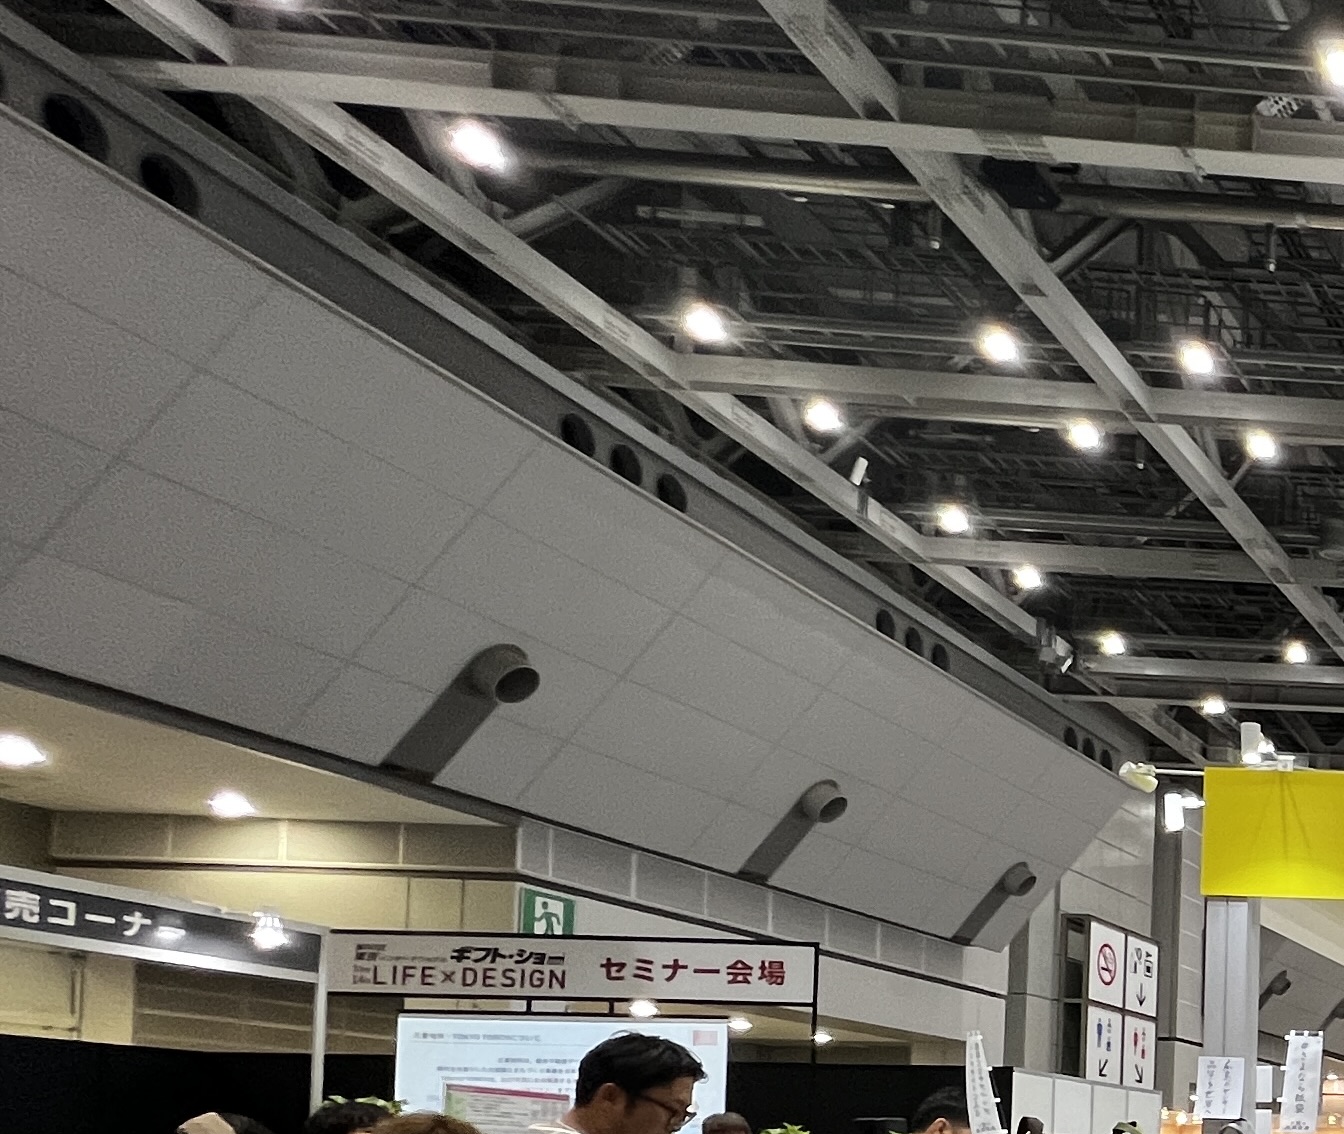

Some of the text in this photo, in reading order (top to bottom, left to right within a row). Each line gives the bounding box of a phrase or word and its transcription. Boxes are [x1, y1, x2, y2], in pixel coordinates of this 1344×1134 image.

[600, 957, 786, 986] セミナー会場
